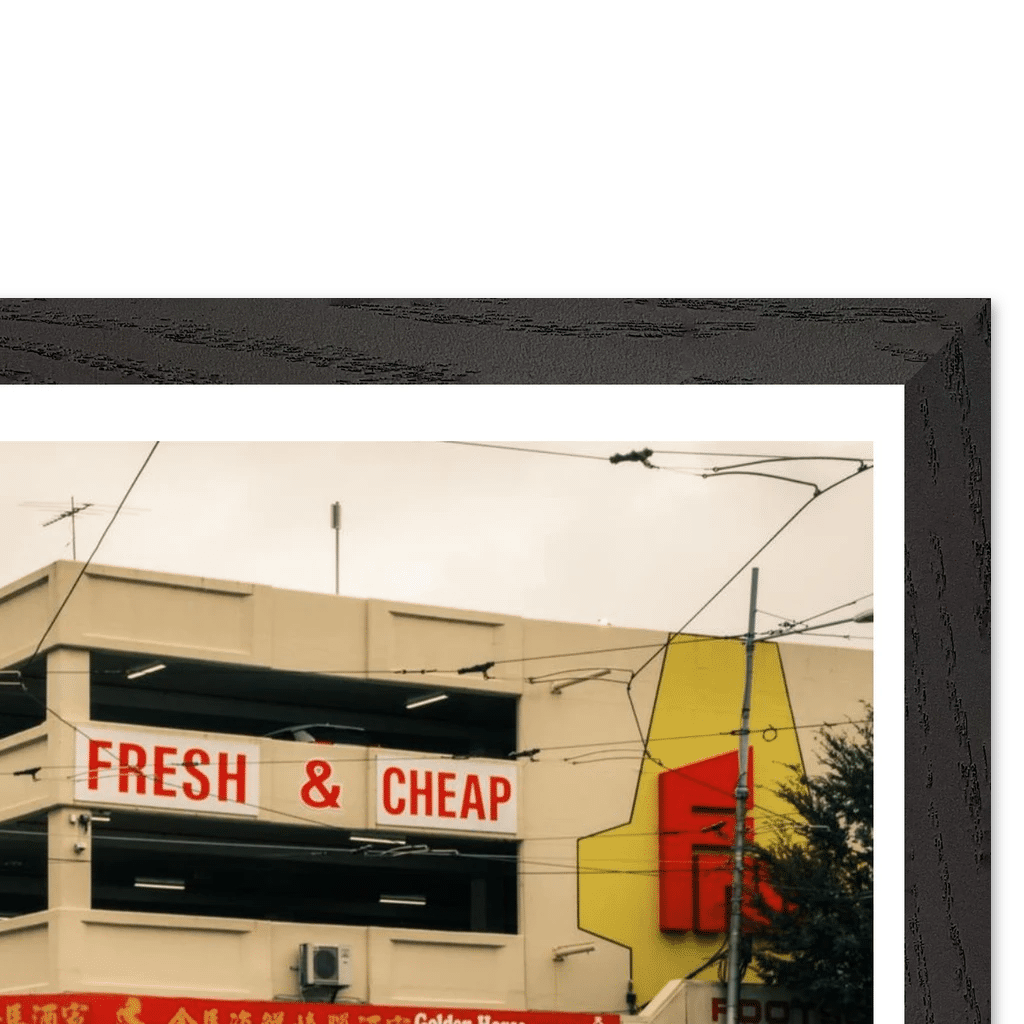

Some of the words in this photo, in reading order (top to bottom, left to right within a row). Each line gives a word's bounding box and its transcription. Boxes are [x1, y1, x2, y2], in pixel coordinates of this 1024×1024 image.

[87, 738, 247, 804] FRESH
[300, 759, 341, 808] &
[382, 766, 512, 822] CHEAP
